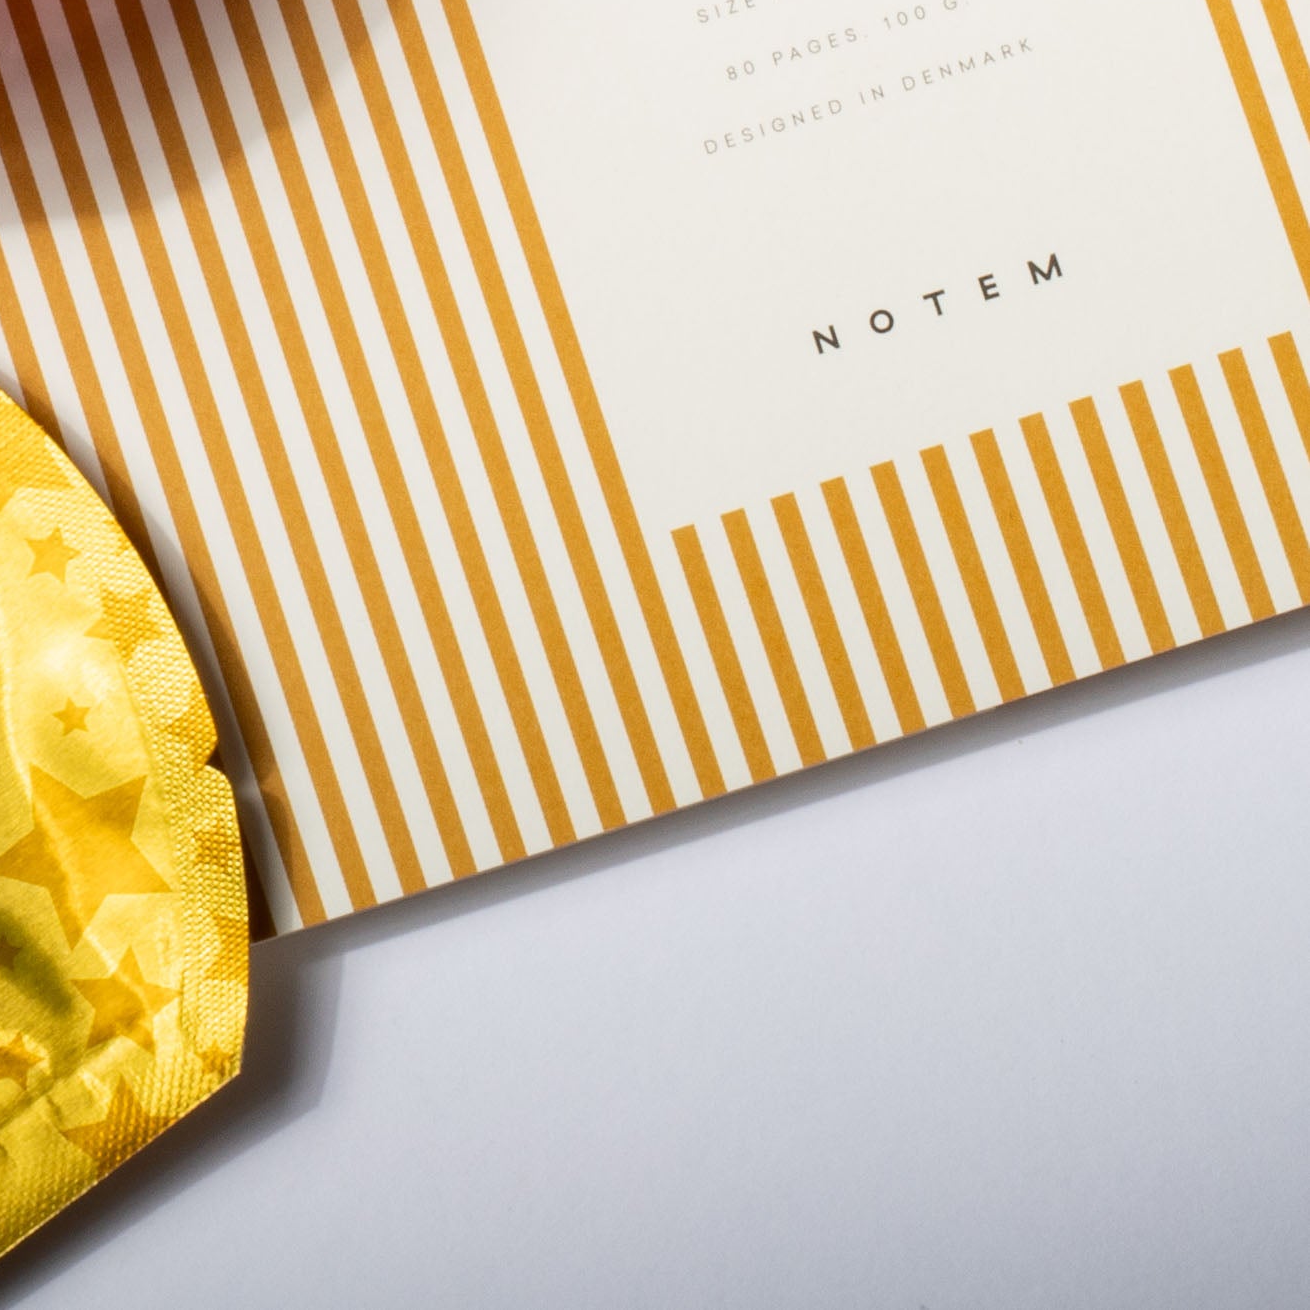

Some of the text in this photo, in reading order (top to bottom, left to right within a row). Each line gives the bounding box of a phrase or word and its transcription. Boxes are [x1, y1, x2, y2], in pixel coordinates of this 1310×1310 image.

[725, 59, 757, 83] 80
[883, 4, 927, 31] 100
[703, 38, 1034, 156] DESIGNED IN DENMARK
[811, 252, 1063, 355] NOTEM
